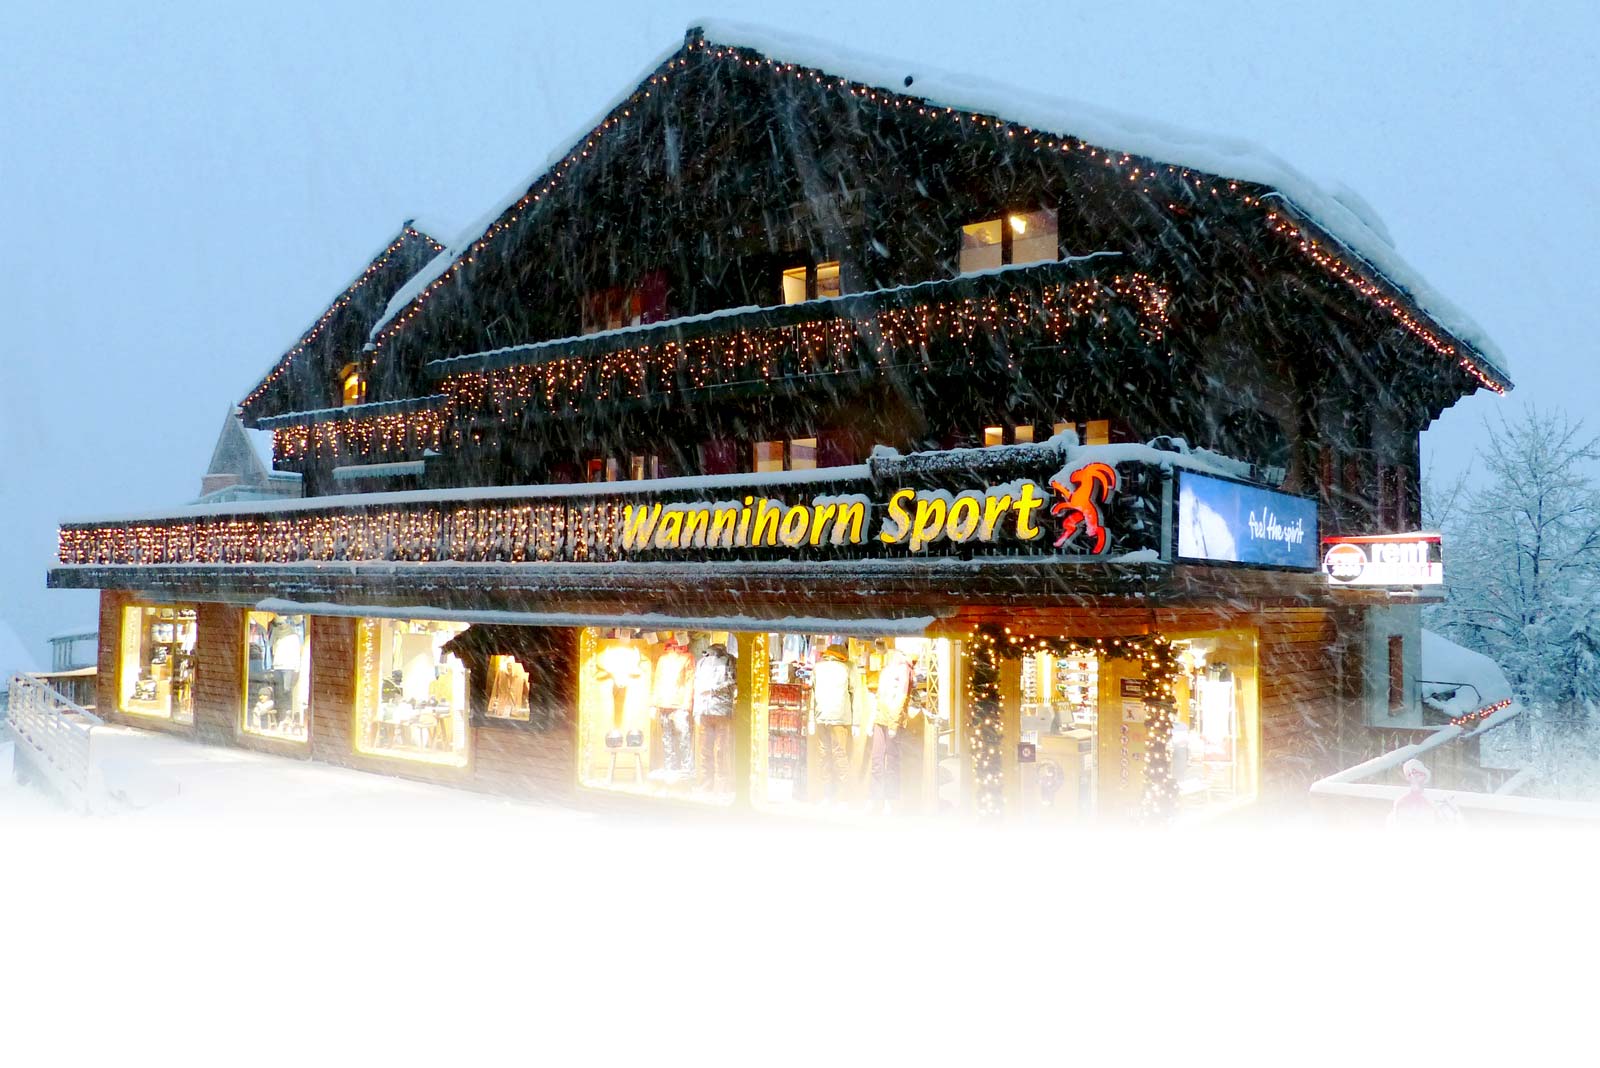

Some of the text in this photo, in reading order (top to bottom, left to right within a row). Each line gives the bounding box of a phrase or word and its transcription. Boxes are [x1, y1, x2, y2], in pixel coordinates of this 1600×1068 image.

[622, 483, 1043, 552] Wannihorn Sport
[1248, 505, 1305, 553] feel the spirit
[1371, 541, 1429, 565] rent
